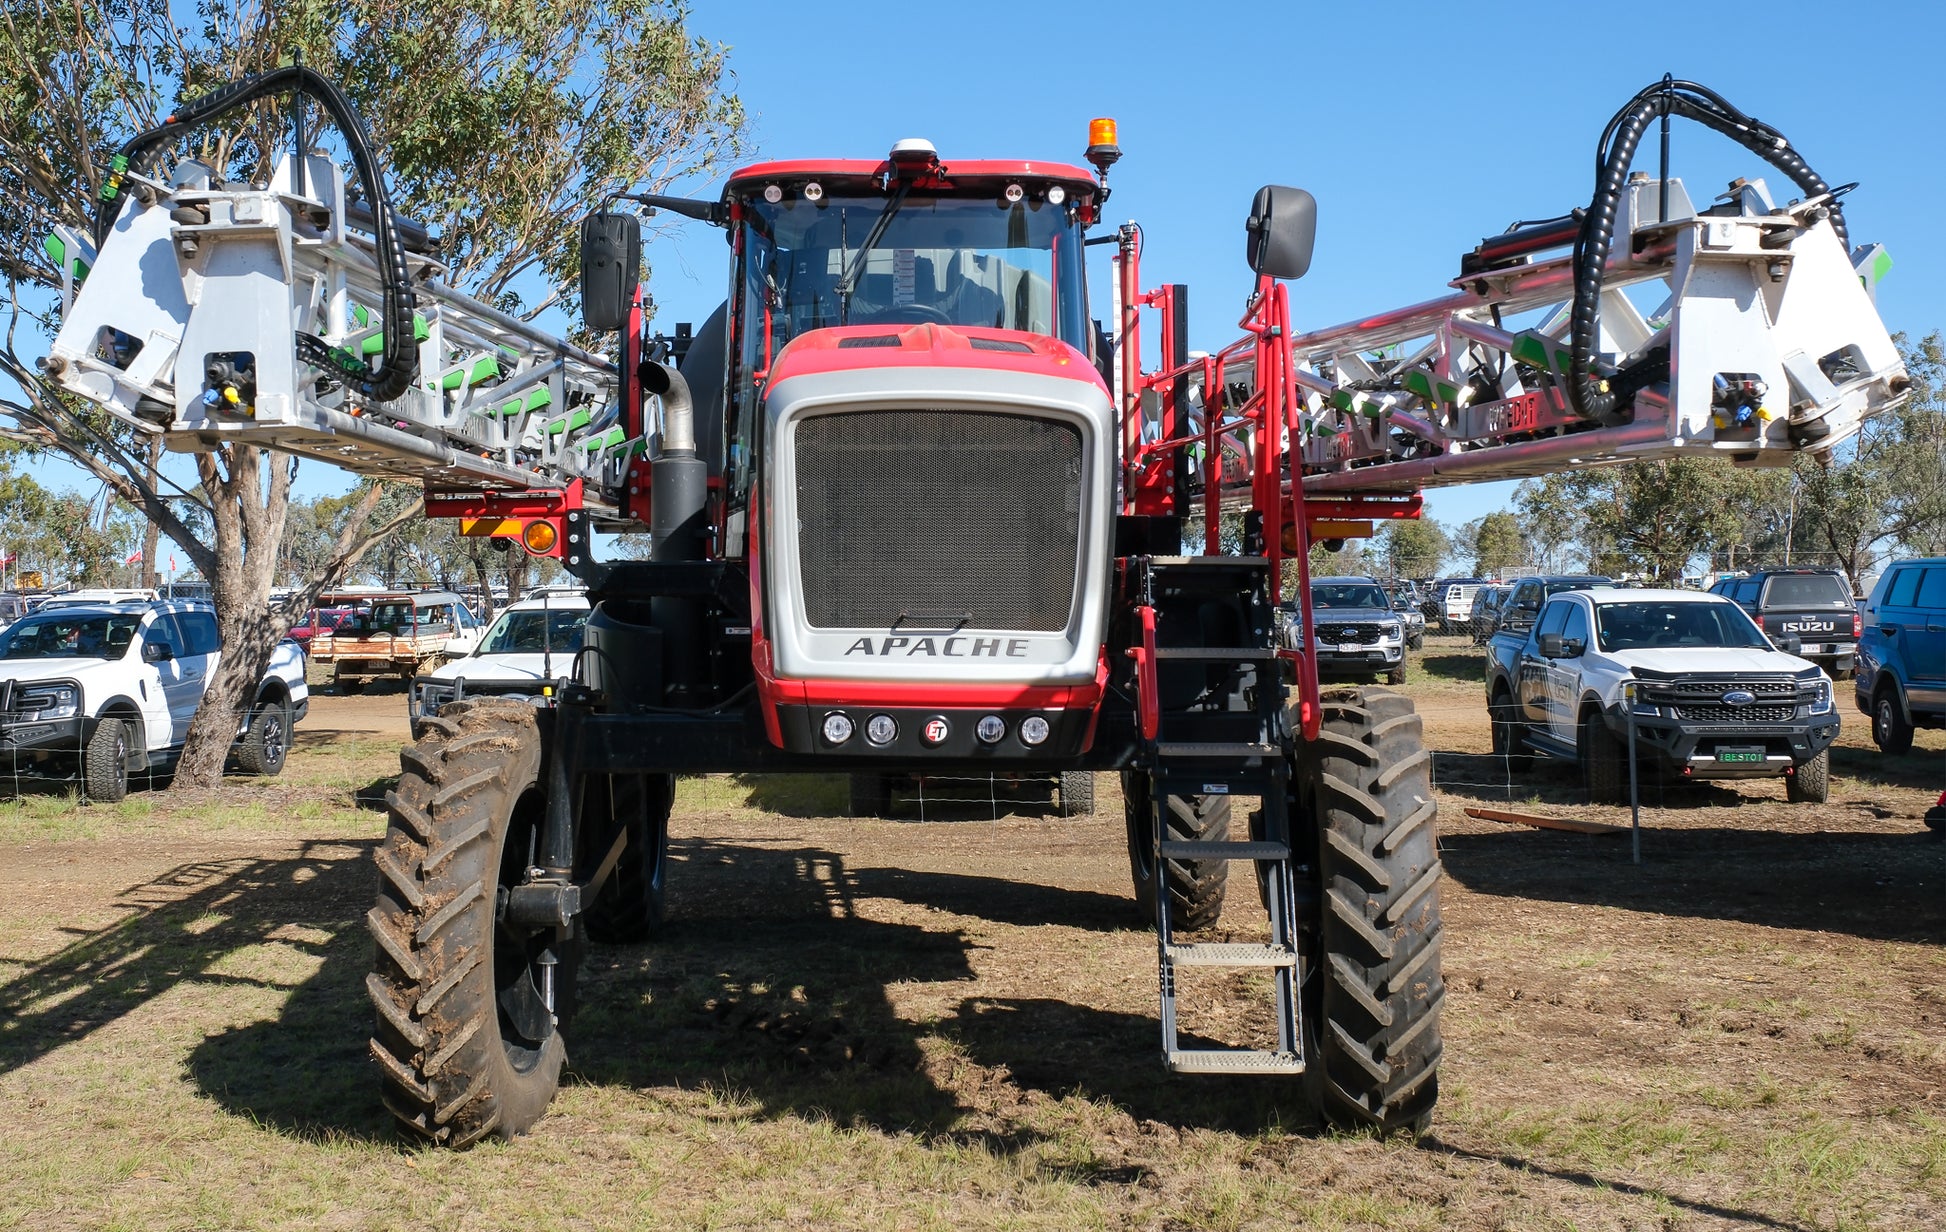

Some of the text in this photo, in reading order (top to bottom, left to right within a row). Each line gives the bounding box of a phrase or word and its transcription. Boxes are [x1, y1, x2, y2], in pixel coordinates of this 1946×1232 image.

[1782, 621, 1834, 632] ISUZU
[844, 637, 1031, 657] APACHE
[928, 722, 945, 739] ET
